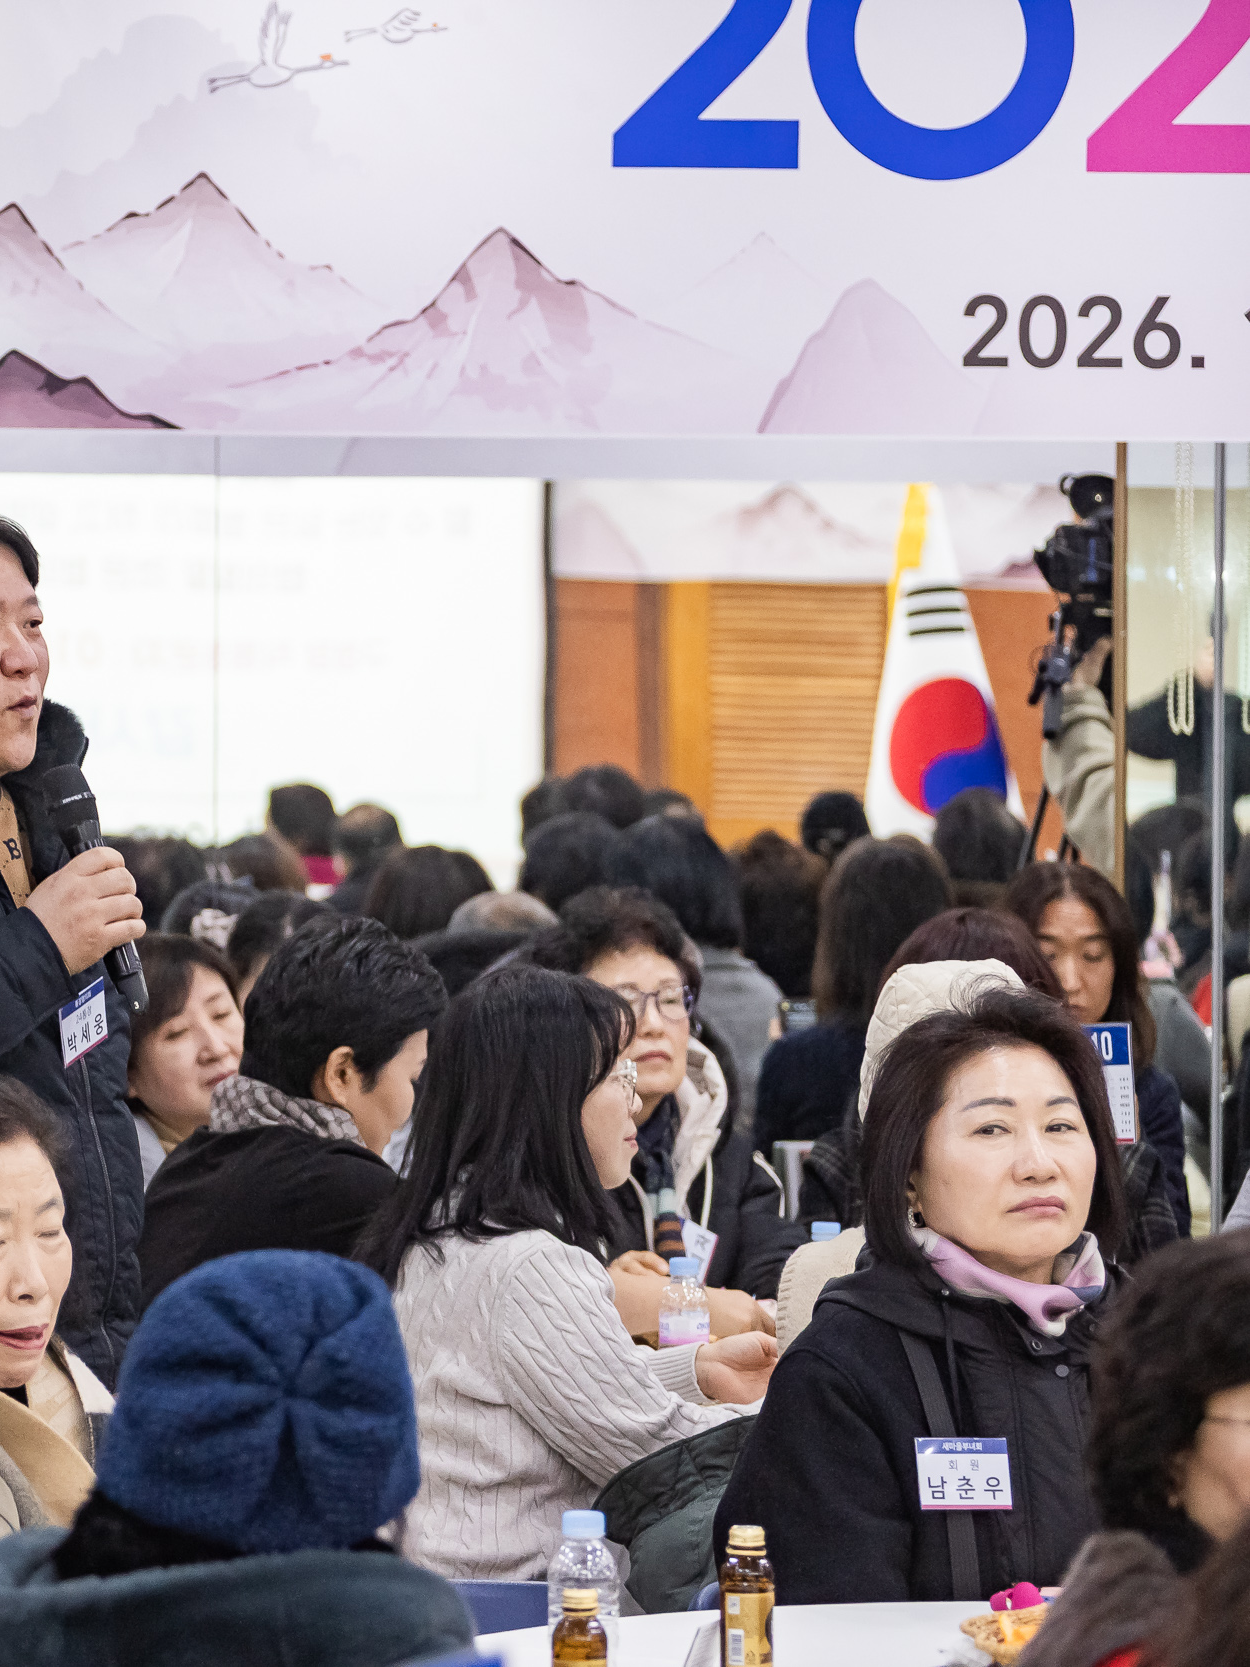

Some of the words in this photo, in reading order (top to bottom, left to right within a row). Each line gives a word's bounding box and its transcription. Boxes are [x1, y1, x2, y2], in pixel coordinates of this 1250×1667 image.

[961, 294, 1206, 369] 2026.
[133, 1000, 140, 1010] 3
[941, 1441, 983, 1452] 새마을부녀회
